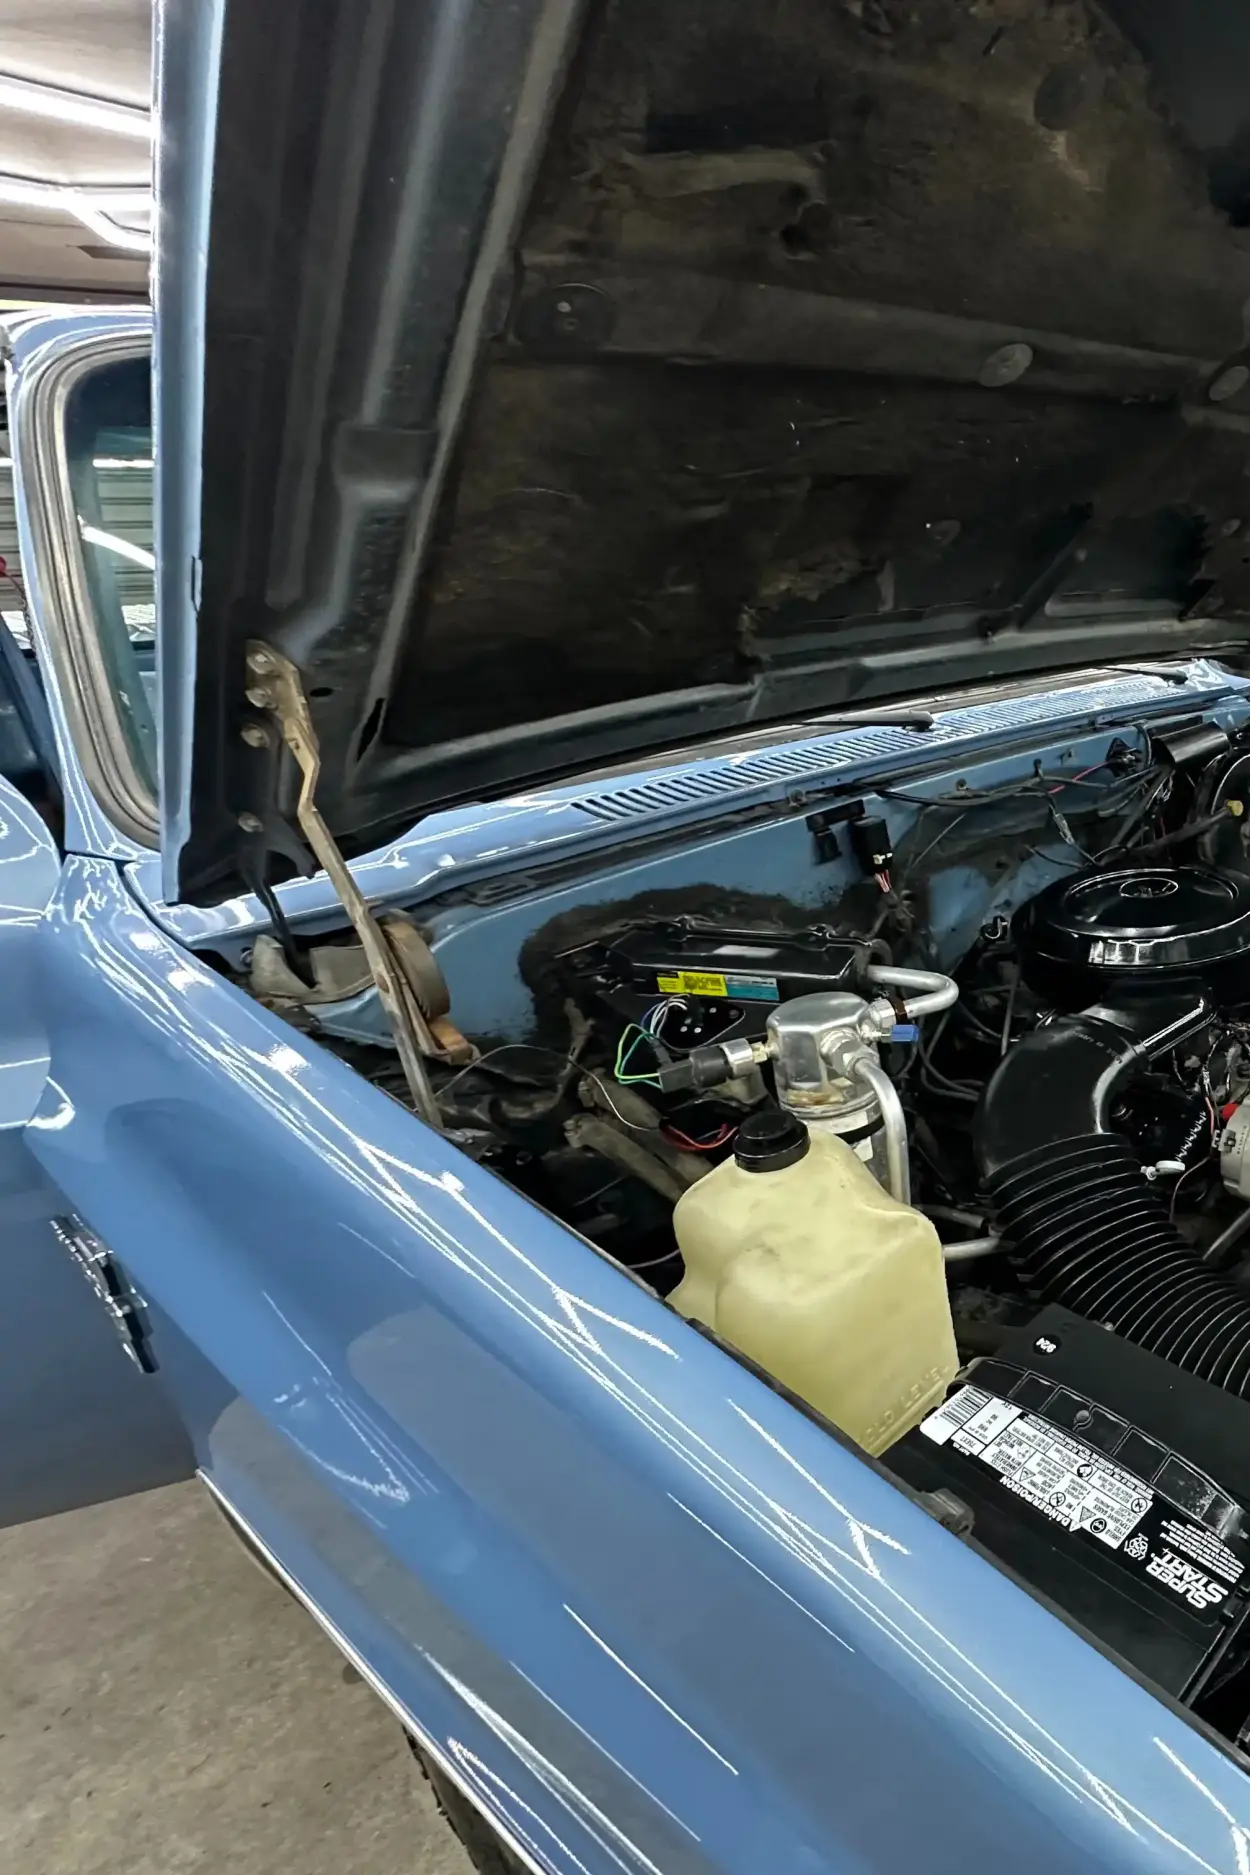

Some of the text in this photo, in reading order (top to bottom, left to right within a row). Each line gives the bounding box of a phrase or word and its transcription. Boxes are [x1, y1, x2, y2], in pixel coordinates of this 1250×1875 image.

[991, 1452, 1017, 1471] IMMEDIATELY
[998, 1474, 1070, 1526] DANGER/POISON
[1092, 1503, 1130, 1530] EXPLOSIVE GASES
[1145, 1561, 1208, 1609] SUPER
[1154, 1553, 1228, 1604] START
